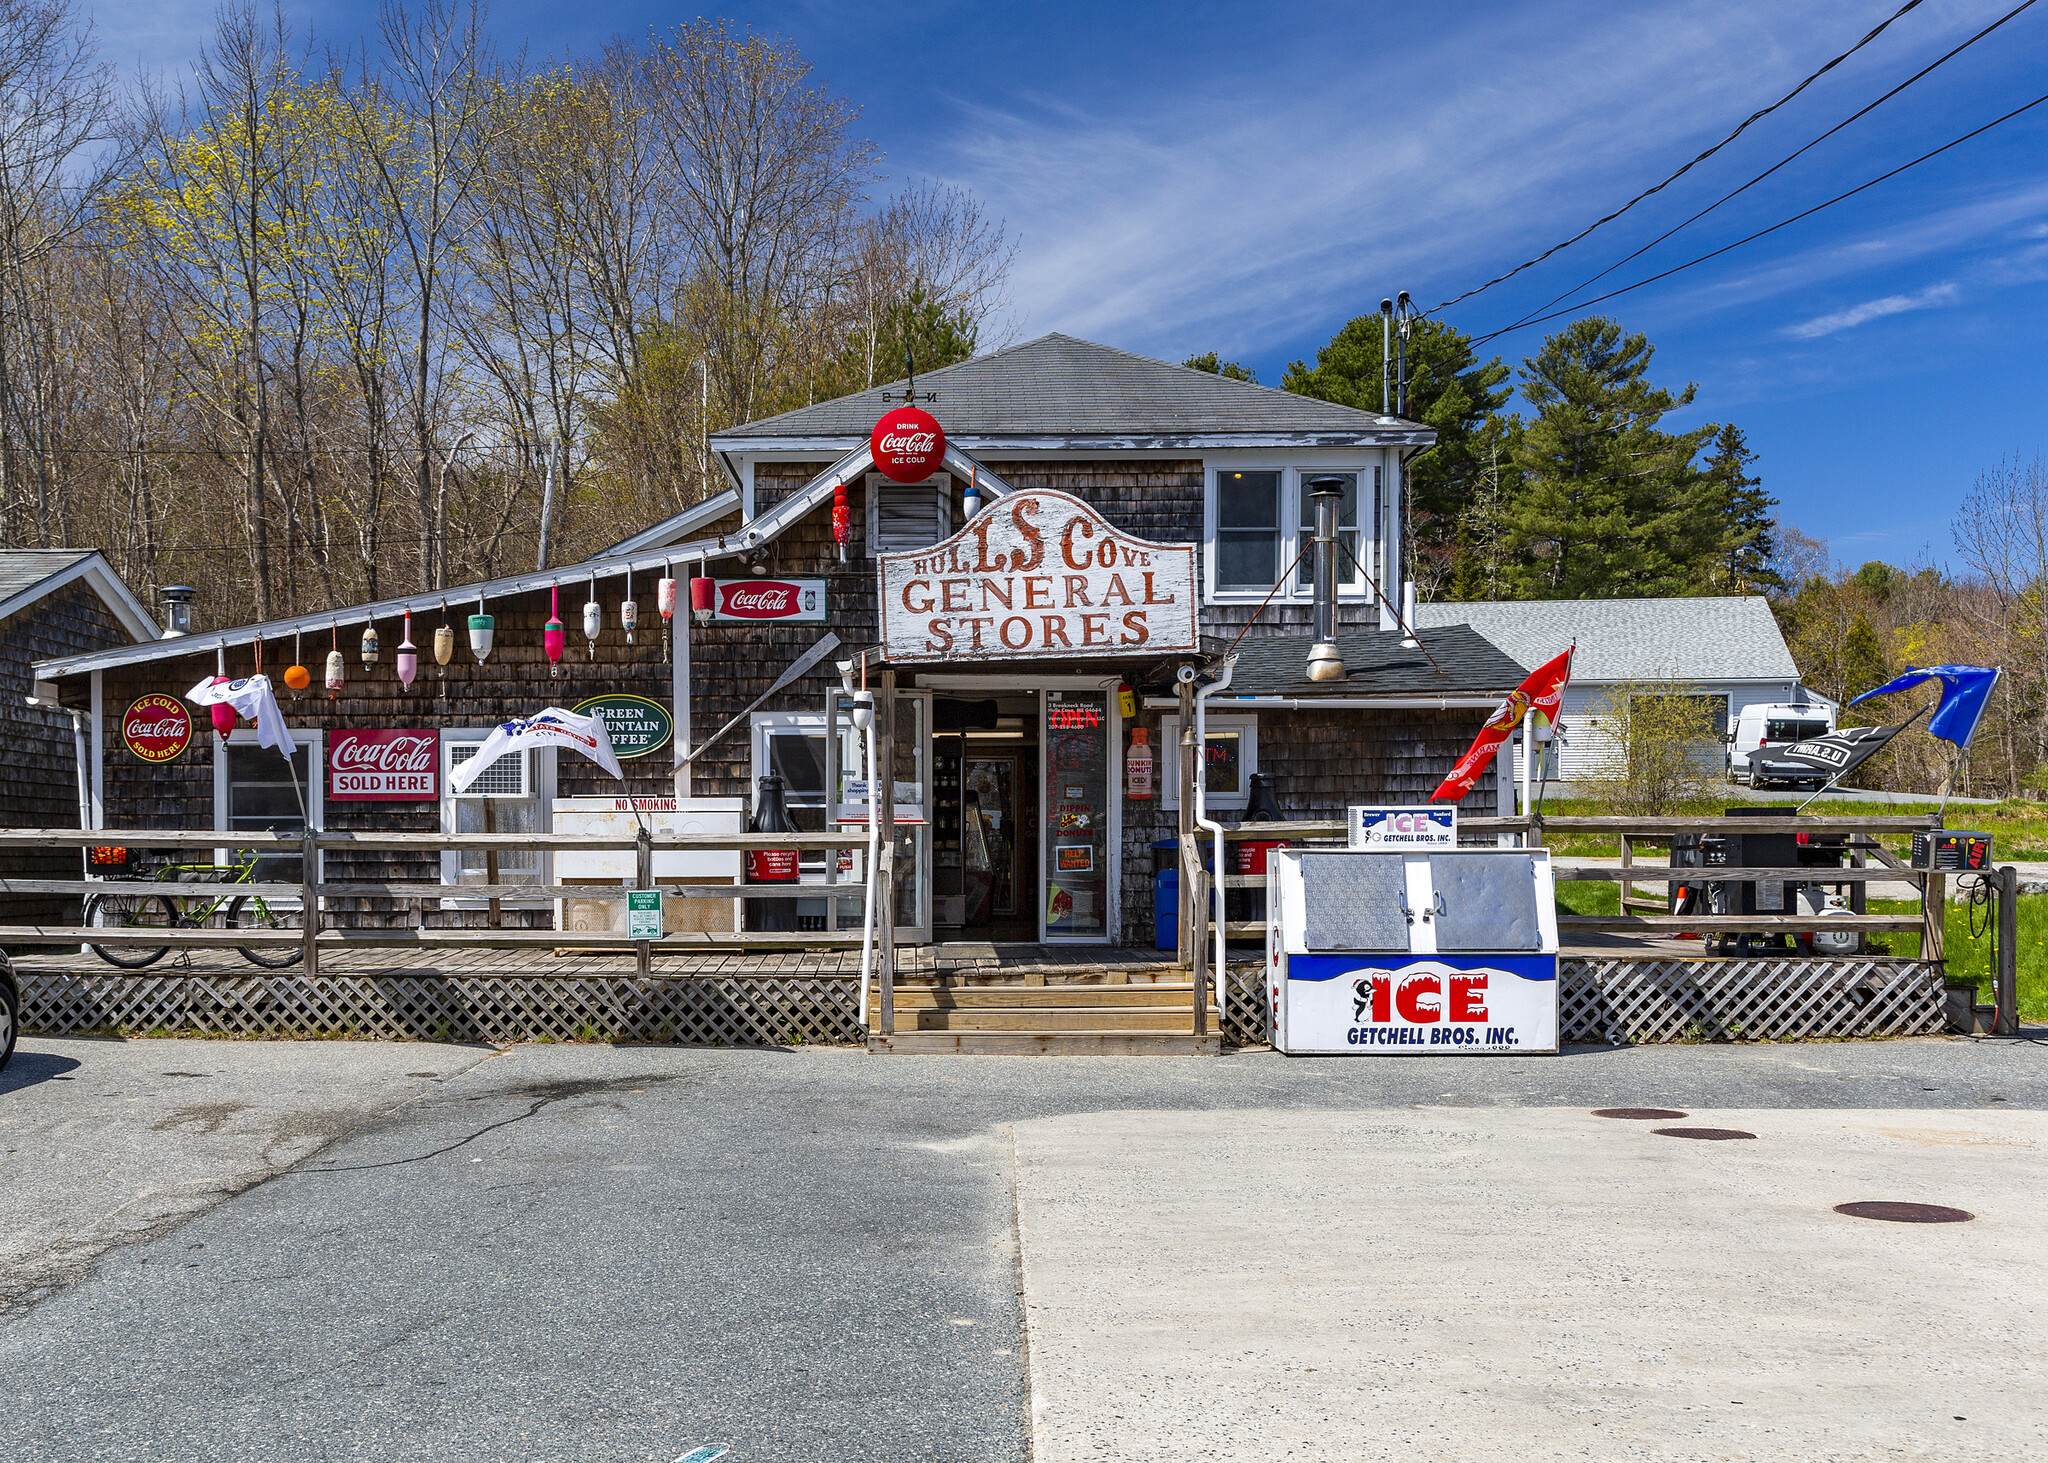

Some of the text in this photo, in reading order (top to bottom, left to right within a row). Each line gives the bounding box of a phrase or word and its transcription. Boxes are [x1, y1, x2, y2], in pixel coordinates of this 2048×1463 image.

[880, 432, 936, 453] Coca-Cola
[906, 456, 926, 464] COLD
[913, 498, 1151, 575] HULLS COVE
[730, 589, 790, 610] Coca-Cola
[901, 571, 1175, 615] GENERAL
[925, 610, 1150, 652] STORES
[133, 697, 179, 714] ICE COLD
[596, 706, 644, 719] GREEN
[605, 721, 660, 732] UNTAIN
[1051, 710, 1098, 728] OPEN
[126, 718, 187, 739] Coca-Cola
[611, 734, 648, 745] FFEE
[133, 741, 181, 758] SOLD HERE
[332, 736, 436, 771] Coca-Cola
[1193, 747, 1227, 763] TM
[338, 776, 428, 791] SOLD HERE
[615, 798, 677, 811] NO SMOKING
[1060, 804, 1090, 812] DIPPIN
[1386, 812, 1428, 832] ICE
[1056, 829, 1094, 837] DONUTS
[1383, 834, 1451, 842] GETCHELL BROS. INC.
[1064, 849, 1084, 858] HELP
[1968, 842, 1985, 869] AIR
[1059, 858, 1090, 868] WANTED
[1371, 971, 1489, 1024] ICE
[1347, 1027, 1519, 1045] GETCHELL BROS. INC.
